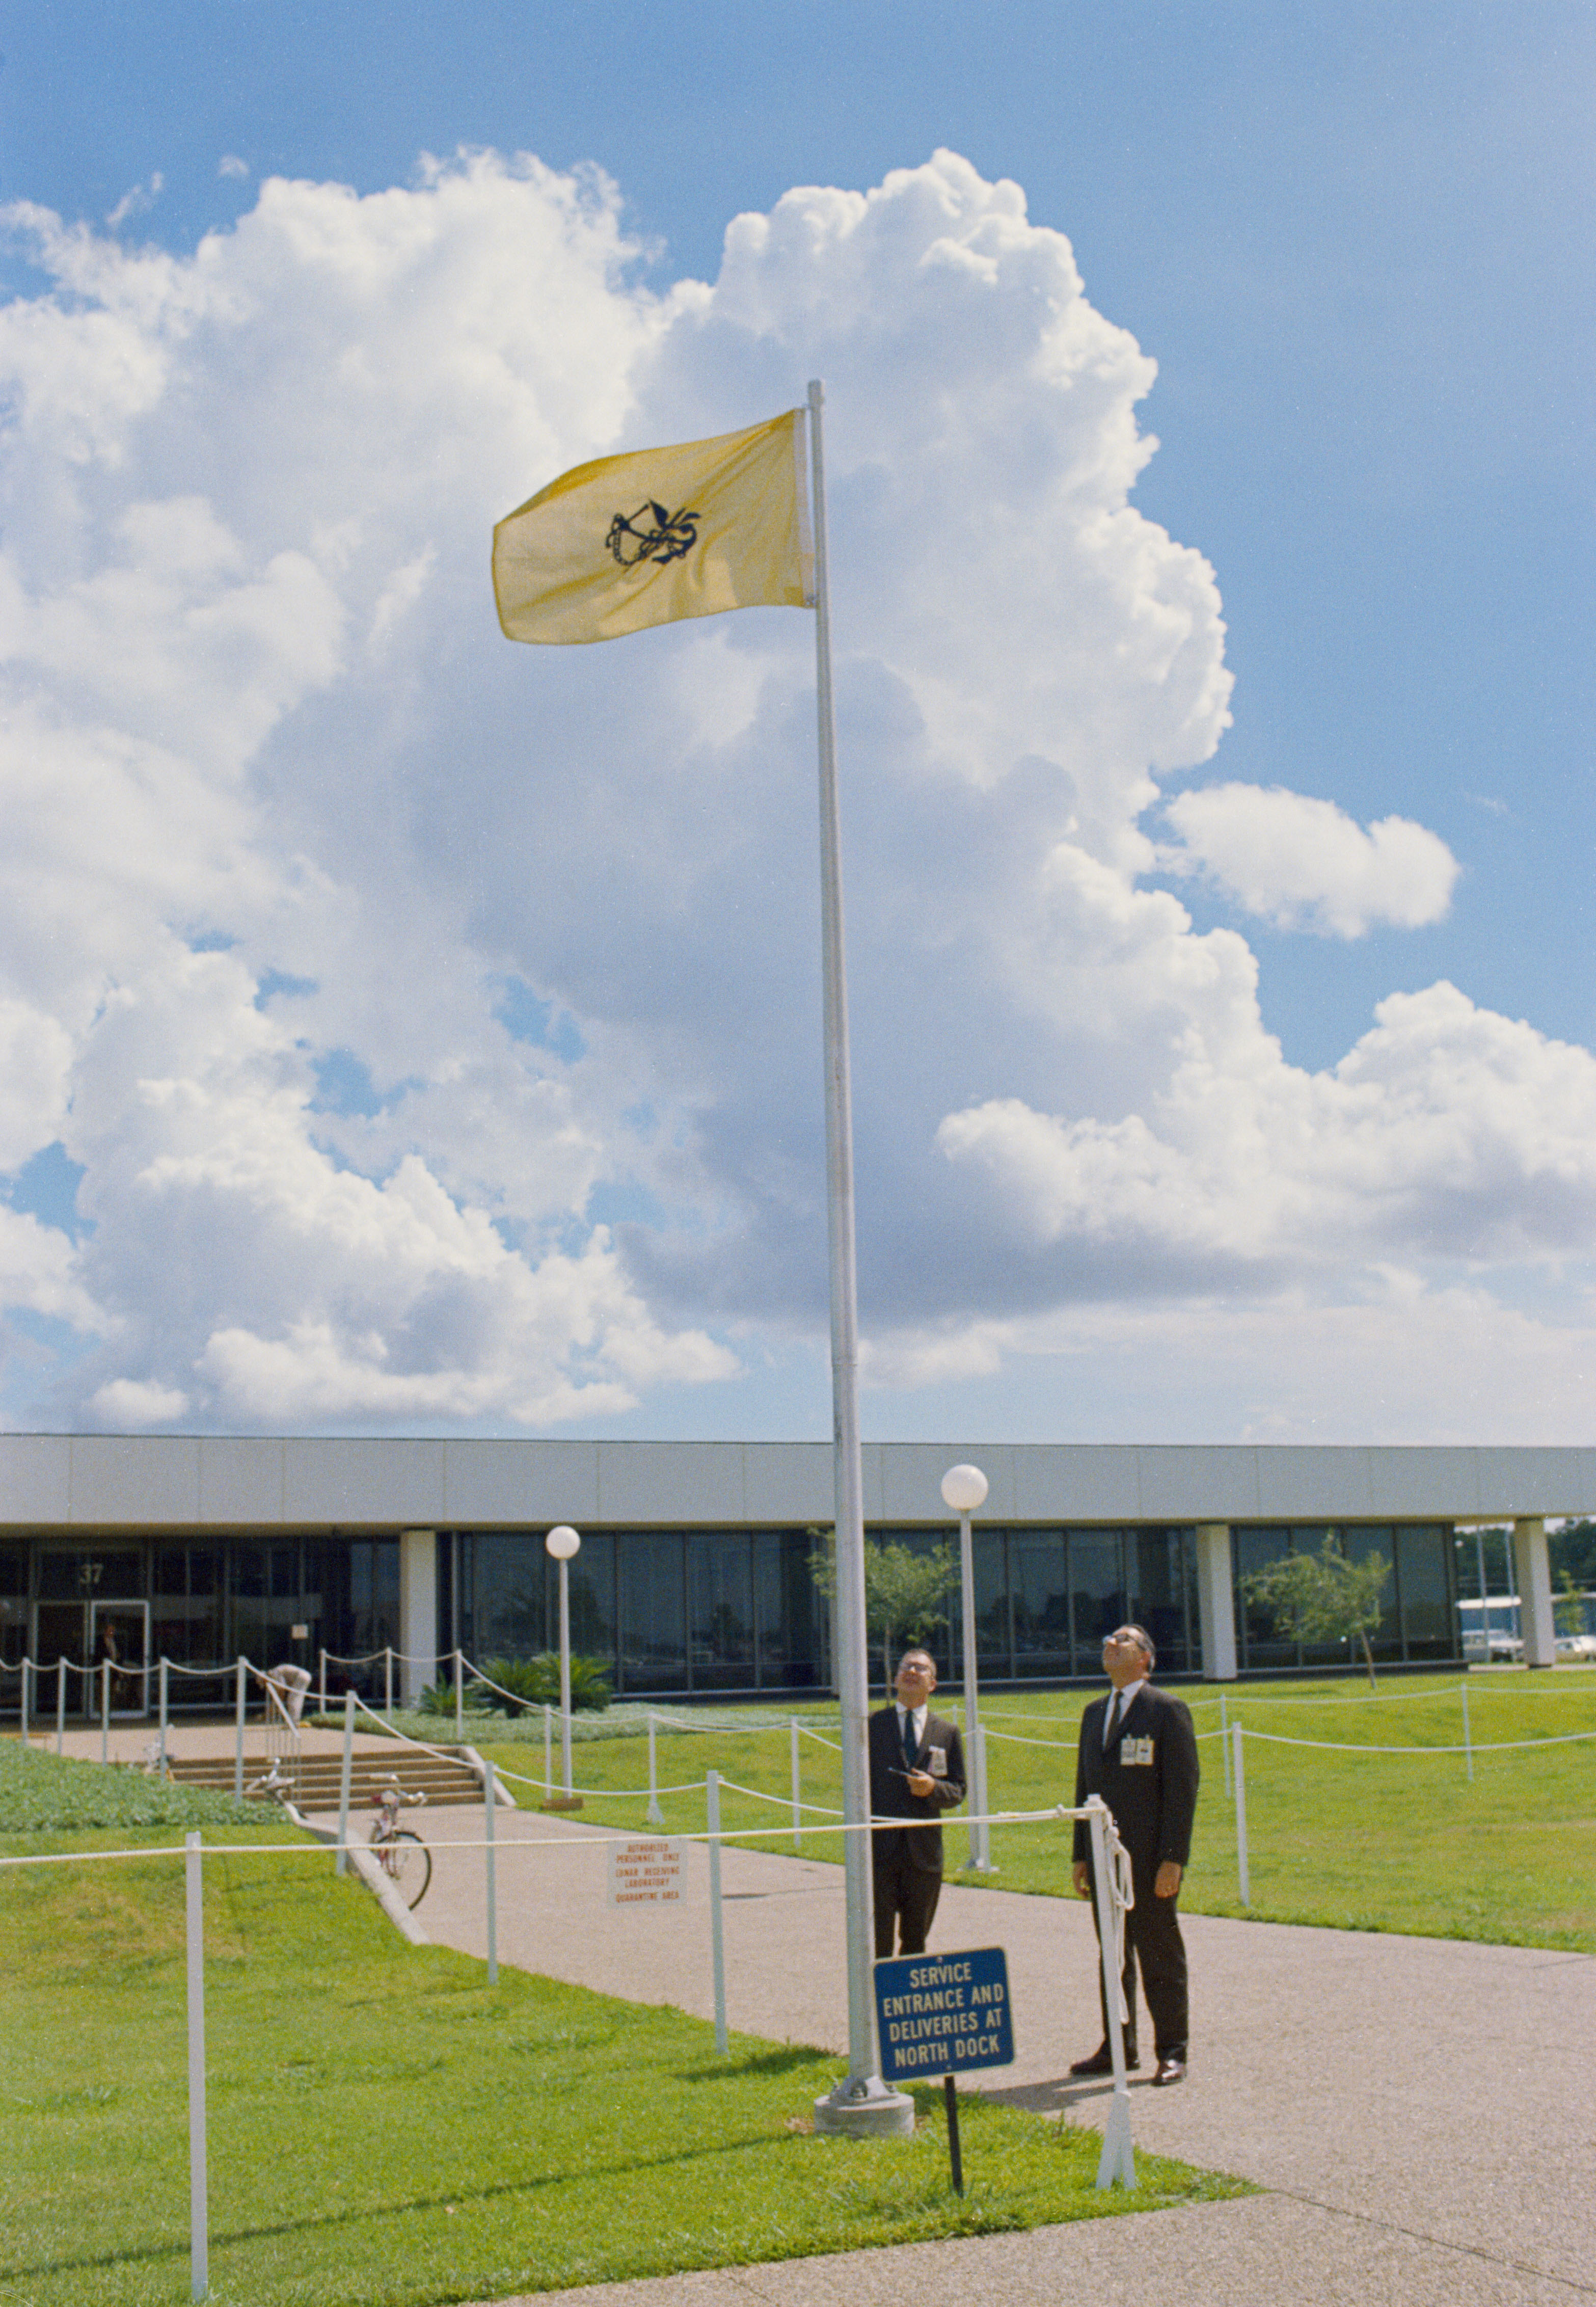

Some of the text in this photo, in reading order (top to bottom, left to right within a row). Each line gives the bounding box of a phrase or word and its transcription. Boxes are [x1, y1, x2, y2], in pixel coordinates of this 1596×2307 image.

[79, 1563, 103, 1584] 37
[616, 1853, 679, 1863] PERSONNEL ONLY
[615, 1866, 679, 1877] LUNAR RECEIVING
[625, 1877, 669, 1887] LABORATORY
[615, 1891, 679, 1902] QUARANTINE AREA
[910, 1963, 972, 1989] SERVICE
[883, 1983, 1004, 2017] ENTRANCE AND
[889, 2008, 1003, 2042] DELIVERIES AT
[895, 2034, 1000, 2067] NORTH DOCK
